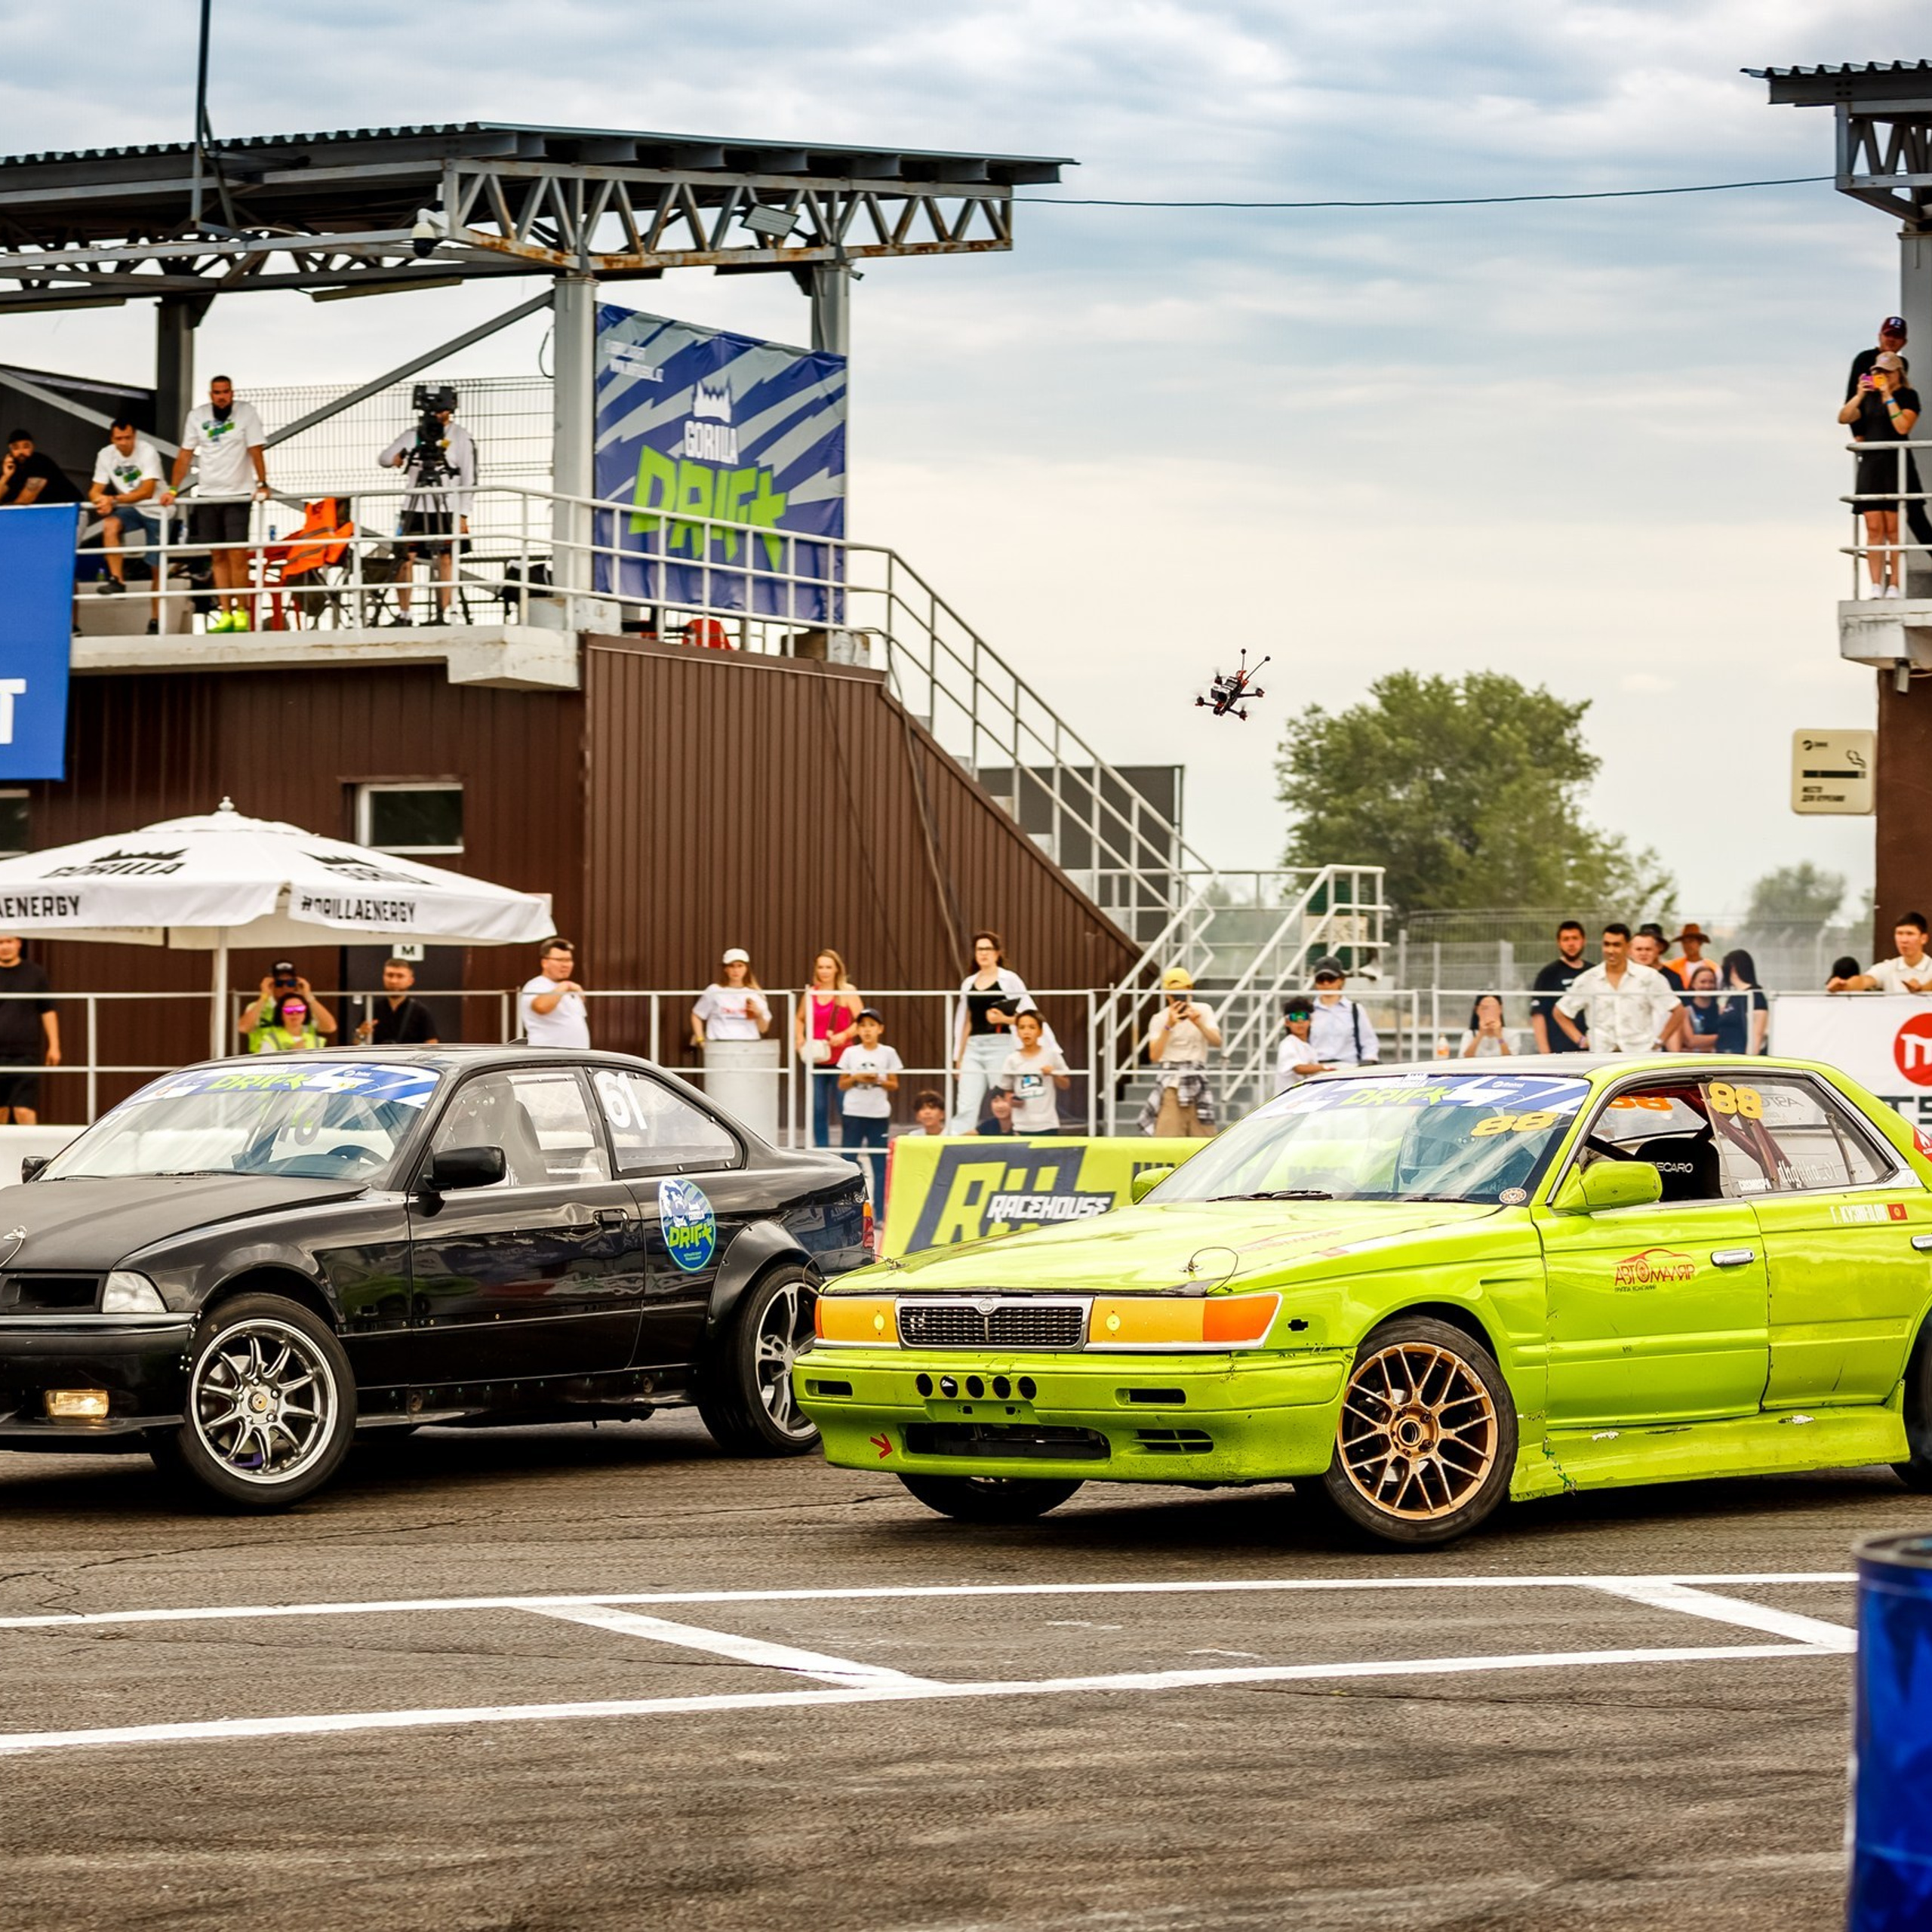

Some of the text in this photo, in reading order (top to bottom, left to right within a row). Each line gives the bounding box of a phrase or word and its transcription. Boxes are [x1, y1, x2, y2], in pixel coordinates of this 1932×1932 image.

[684, 420, 739, 465] GORILLA
[629, 445, 789, 572] DRIFT
[205, 1072, 312, 1091] DRIFT
[1339, 1085, 1454, 1106] DRIFT
[593, 1070, 648, 1131] 61
[1708, 1081, 1764, 1120] 88
[1470, 1111, 1558, 1137] 88
[986, 1195, 1112, 1223] RACEHOUSE
[669, 1223, 712, 1249] DRIFT
